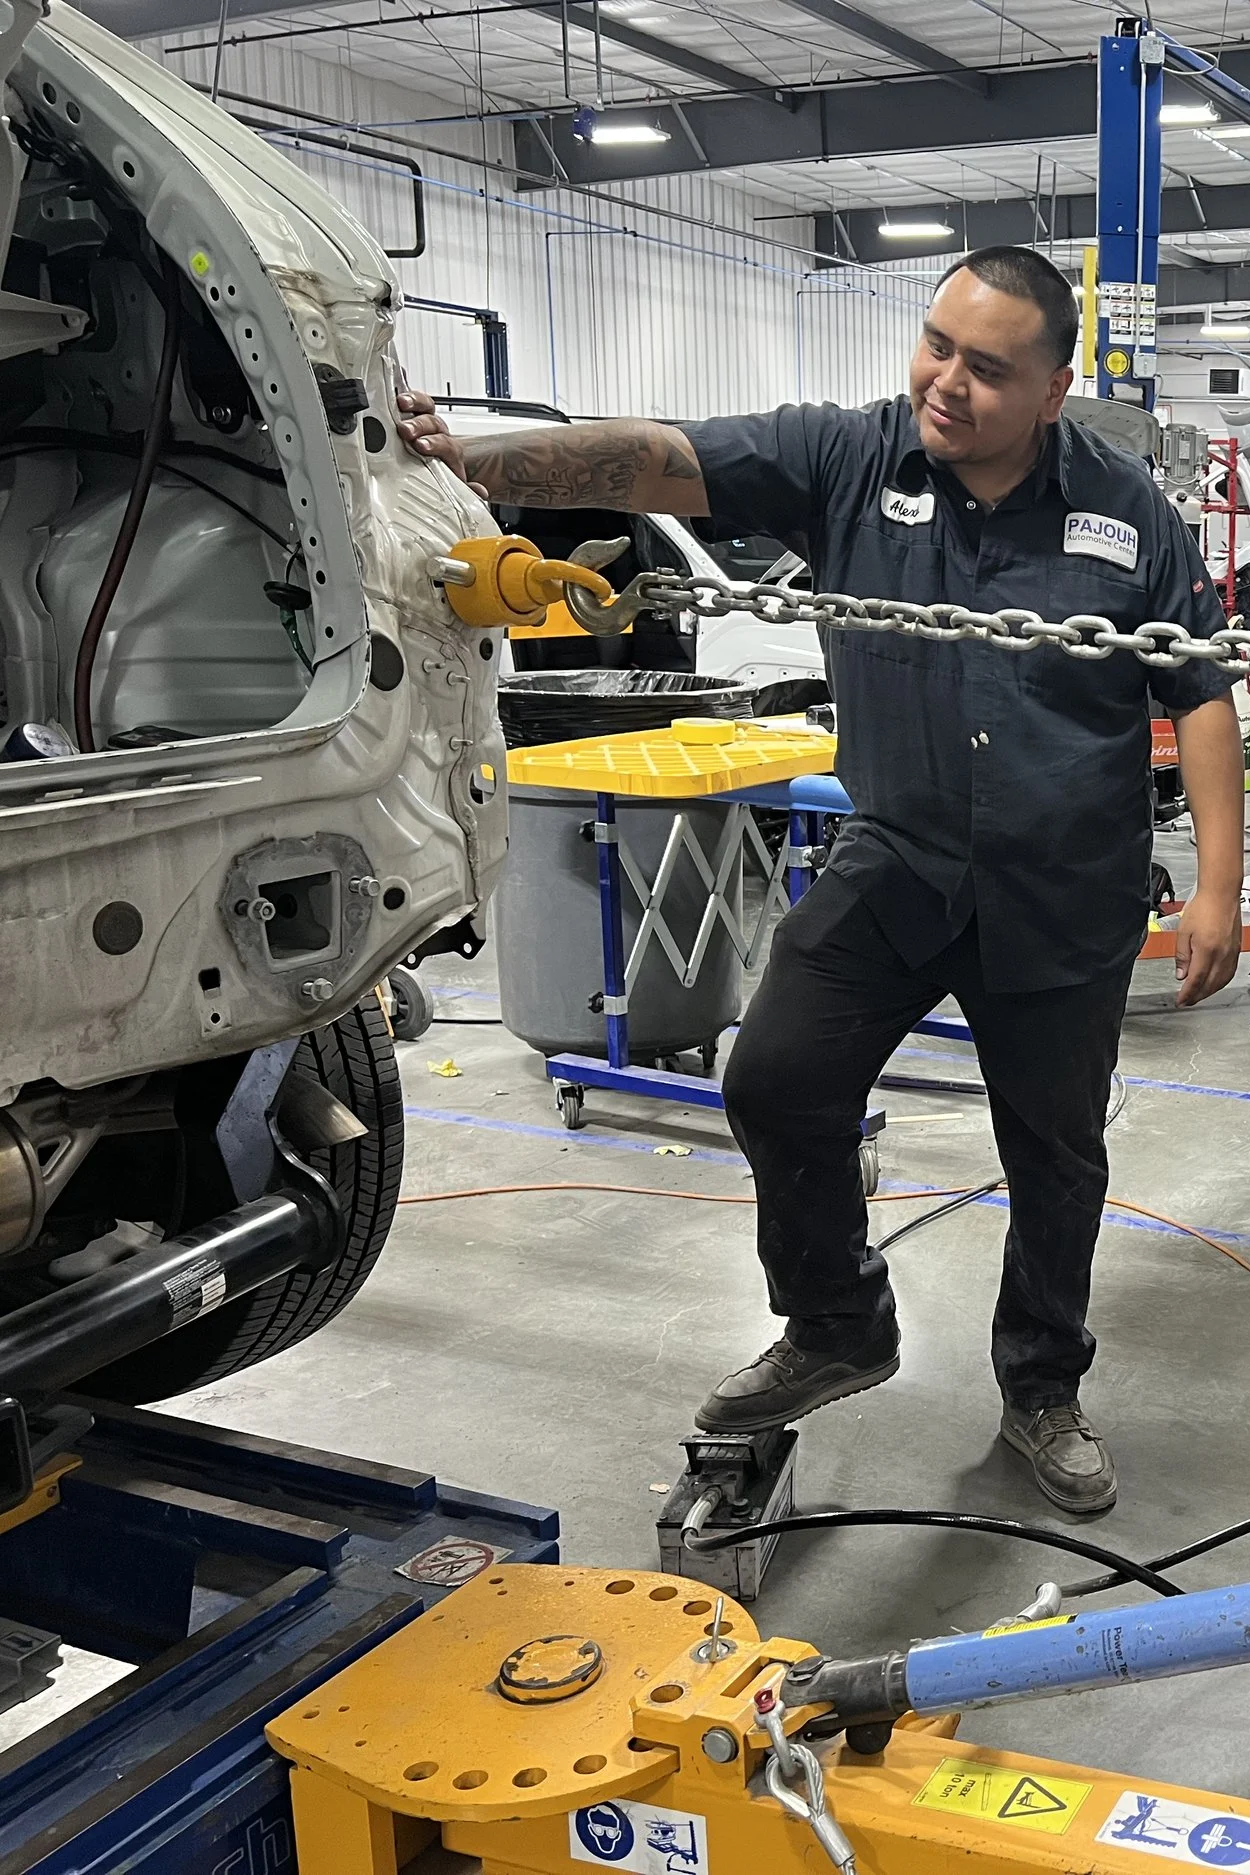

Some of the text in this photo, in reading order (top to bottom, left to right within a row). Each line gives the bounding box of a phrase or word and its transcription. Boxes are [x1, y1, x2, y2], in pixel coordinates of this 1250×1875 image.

[889, 500, 920, 518] Alex
[1066, 533, 1136, 557] Automotive Center
[1067, 518, 1137, 549] PAJOUH
[1113, 1626, 1123, 1661] Power
[939, 1773, 965, 1799] 10 ton
[958, 1779, 976, 1798] max
